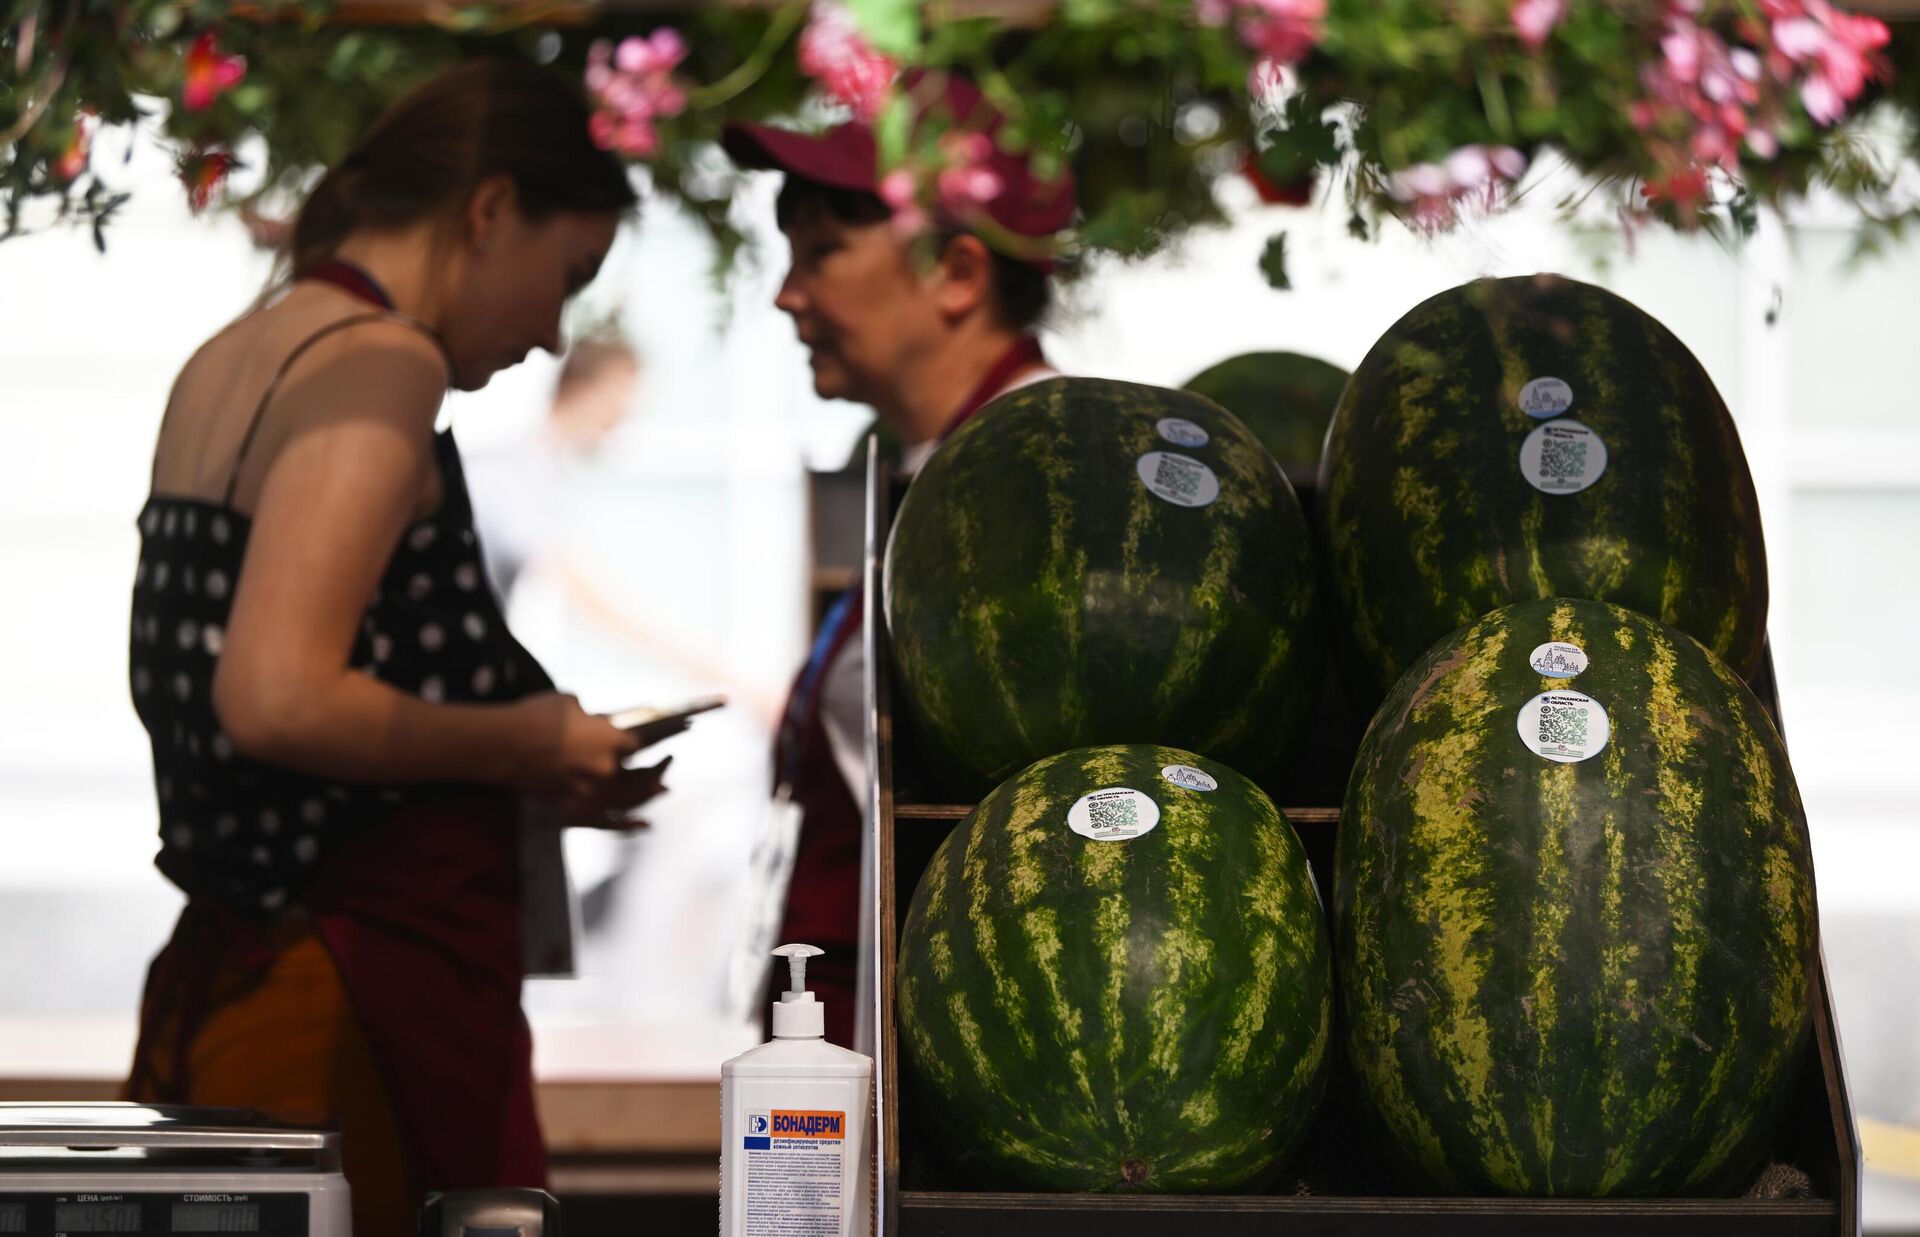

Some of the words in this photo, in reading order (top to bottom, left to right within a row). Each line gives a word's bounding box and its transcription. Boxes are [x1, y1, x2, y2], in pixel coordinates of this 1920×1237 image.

[773, 1115, 840, 1135] БОНАДЕРМ
[77, 1194, 99, 1203] ЦЕНА
[183, 1194, 232, 1203] СТОИМОСТЬ
